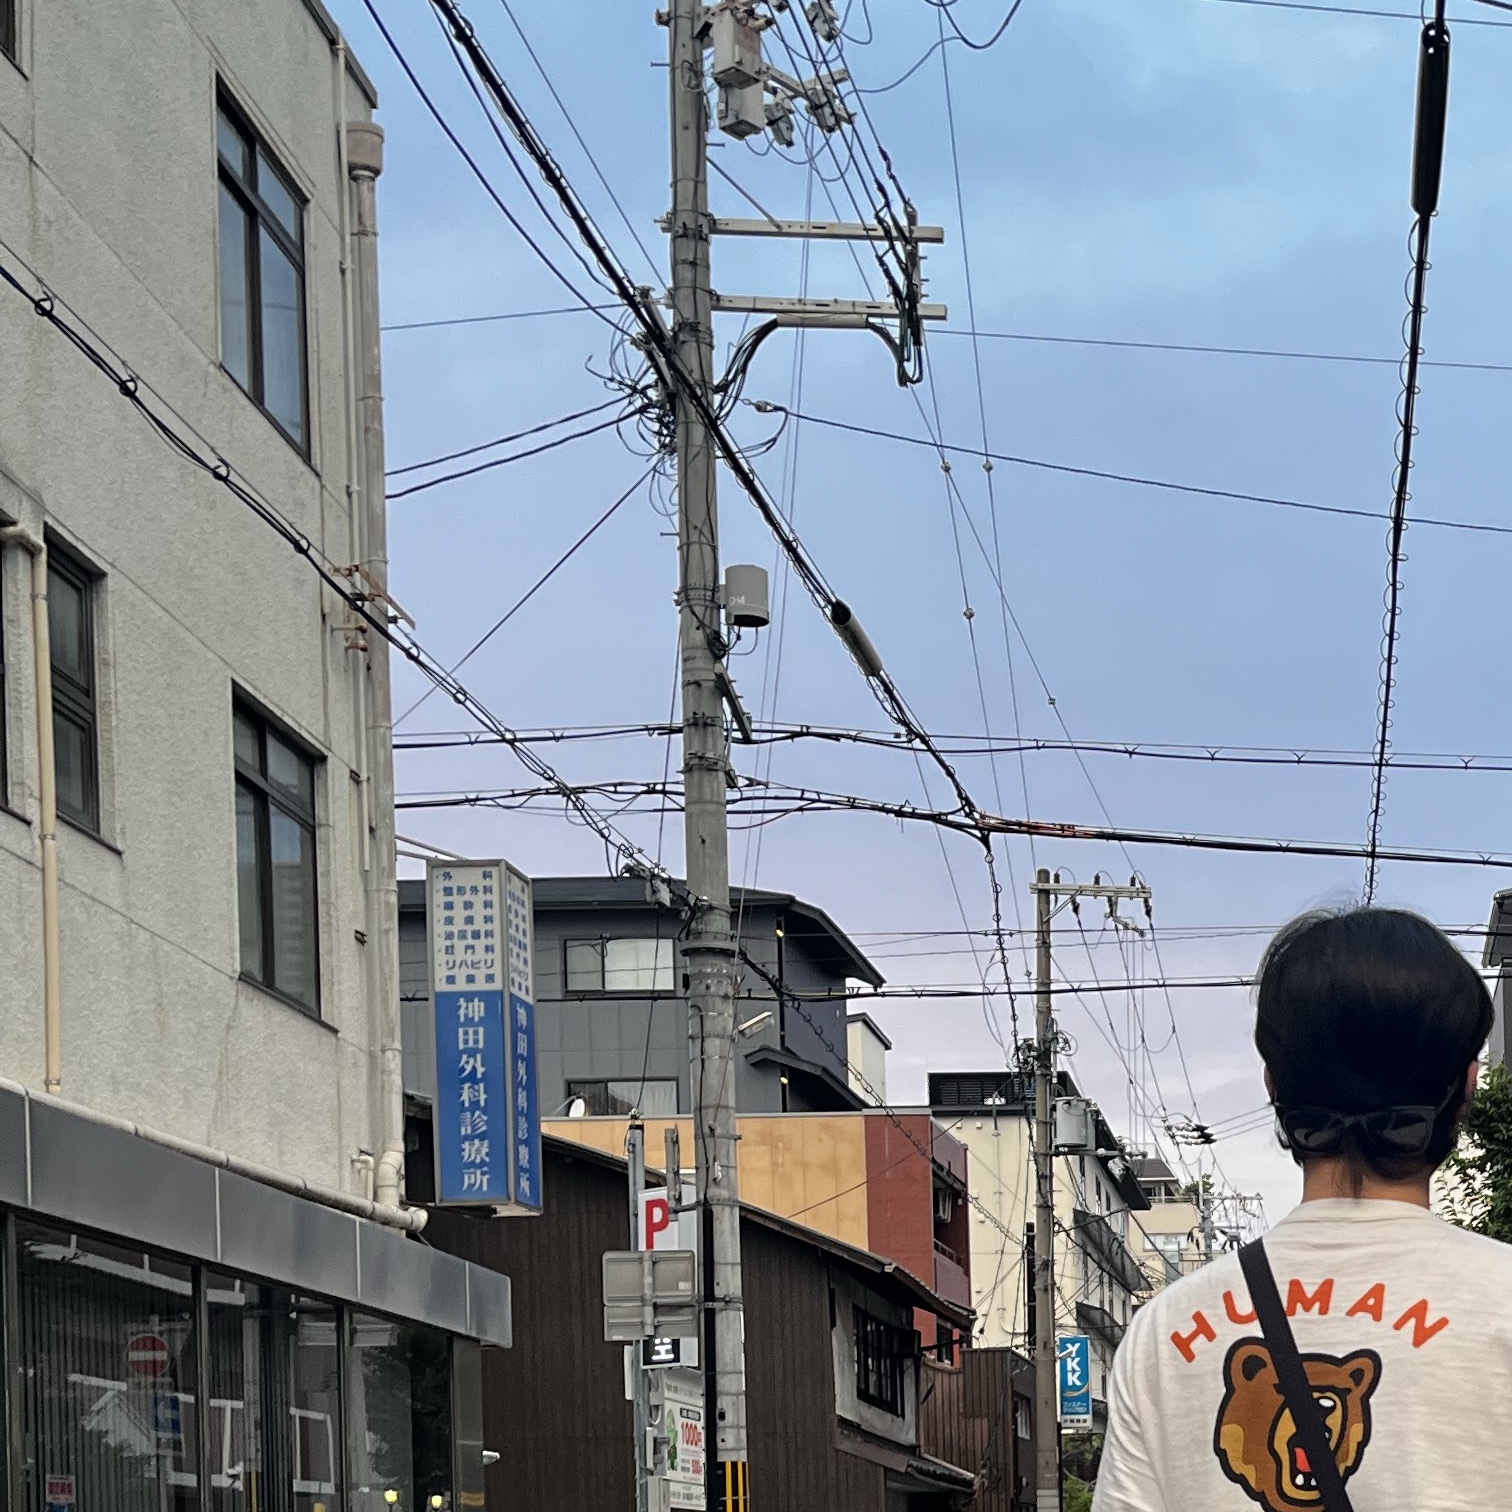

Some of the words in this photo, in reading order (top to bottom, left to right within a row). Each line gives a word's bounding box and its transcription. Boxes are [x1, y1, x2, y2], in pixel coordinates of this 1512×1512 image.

[445, 959, 495, 970] リハビリ
[456, 997, 490, 1192] 神田外科診療所
[645, 1198, 670, 1250] P
[1170, 1278, 1449, 1363] HUMAN
[1065, 1343, 1082, 1386] YKK
